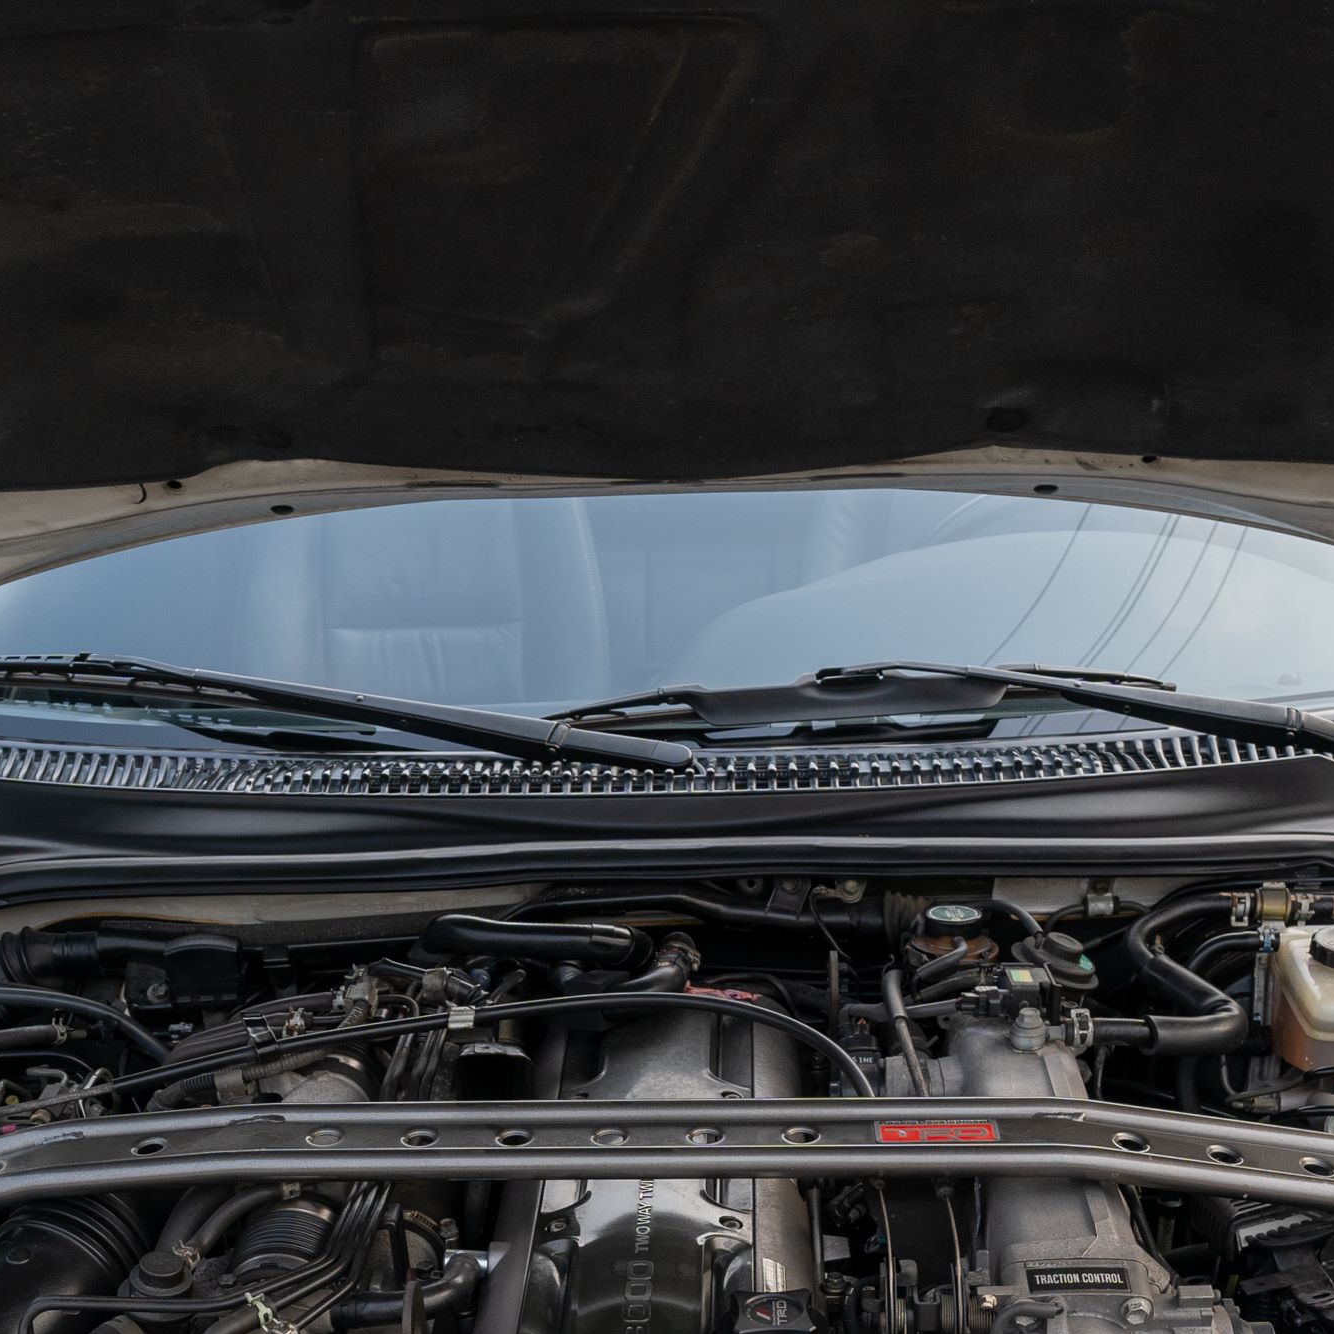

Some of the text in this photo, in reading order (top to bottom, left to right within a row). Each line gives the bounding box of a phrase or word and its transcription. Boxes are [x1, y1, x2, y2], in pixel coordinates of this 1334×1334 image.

[884, 1127, 989, 1142] TRD
[637, 1203, 652, 1226] WAY
[635, 1226, 651, 1253] TWO
[1034, 1273, 1124, 1285] TRACTION CONTROL
[776, 1300, 788, 1326] TRD
